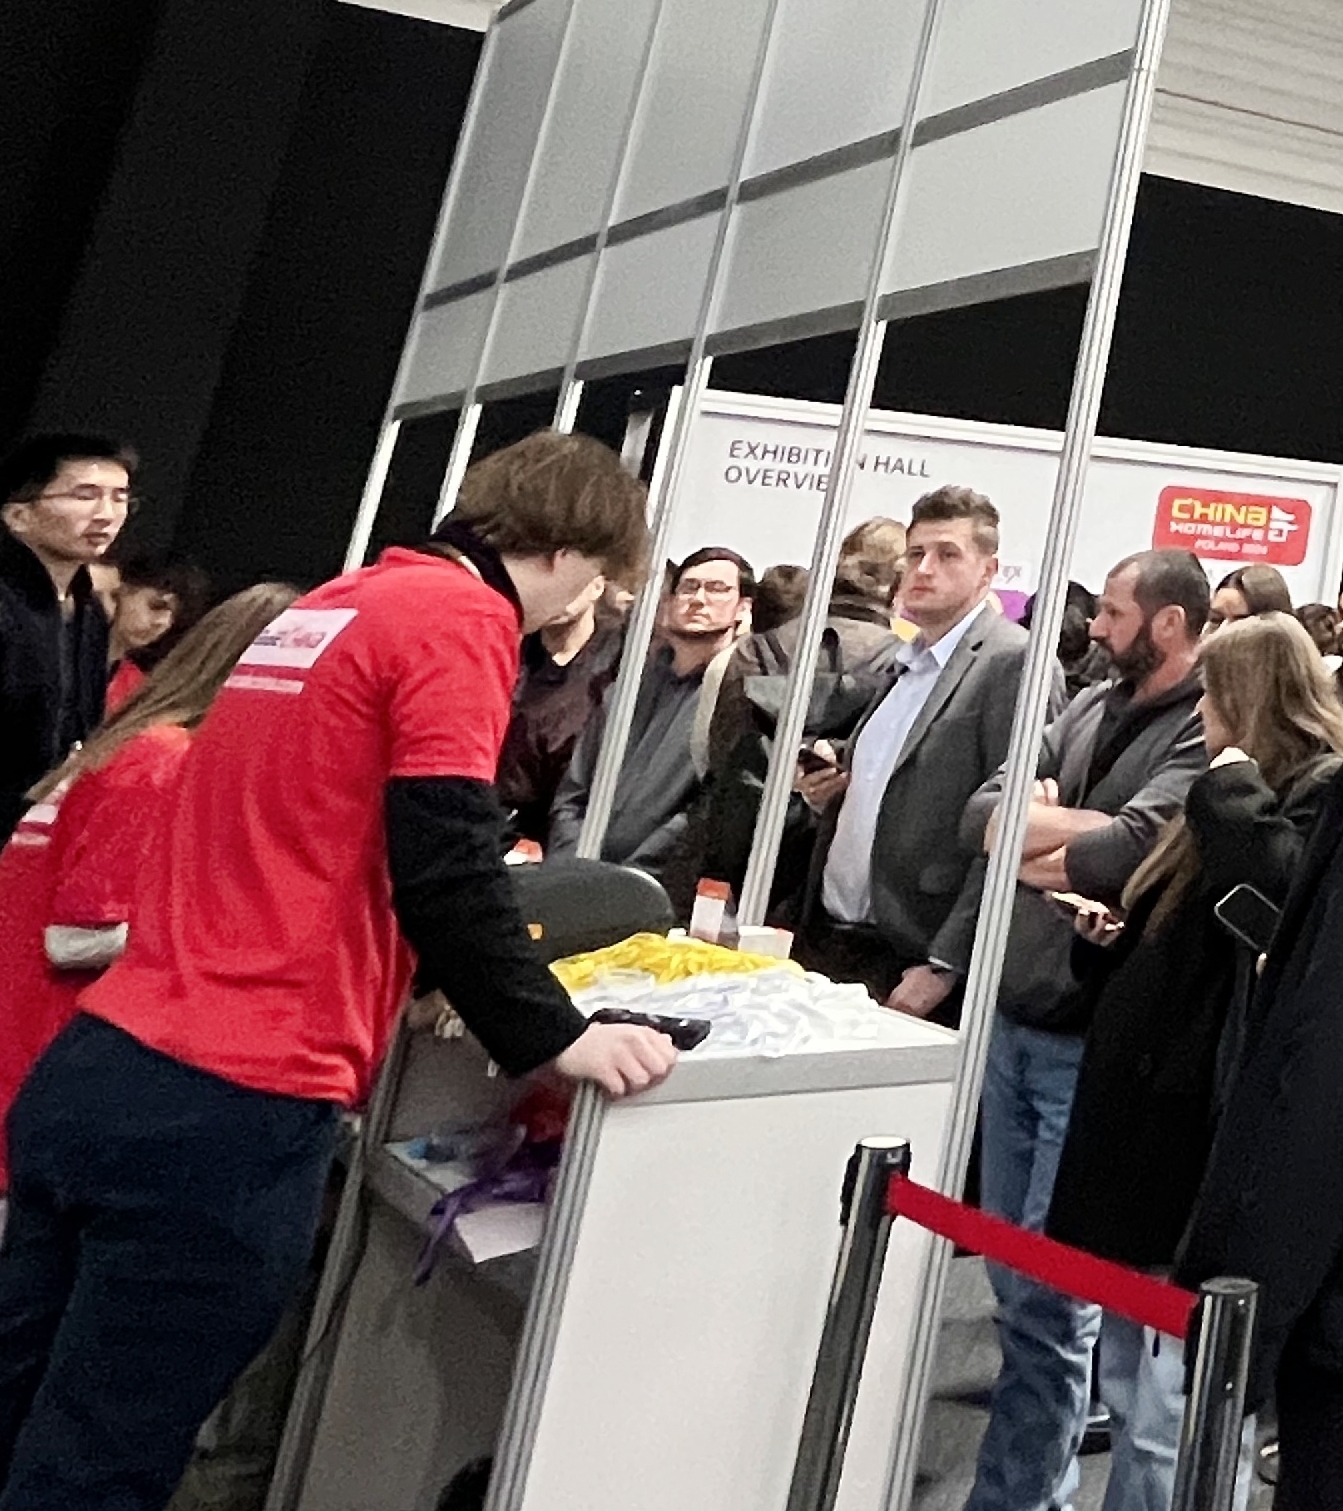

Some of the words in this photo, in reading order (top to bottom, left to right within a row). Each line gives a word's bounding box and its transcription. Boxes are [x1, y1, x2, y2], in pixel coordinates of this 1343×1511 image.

[729, 440, 868, 470] EXHIBITIN
[873, 455, 931, 477] HALL
[724, 465, 829, 493] OVERVIE
